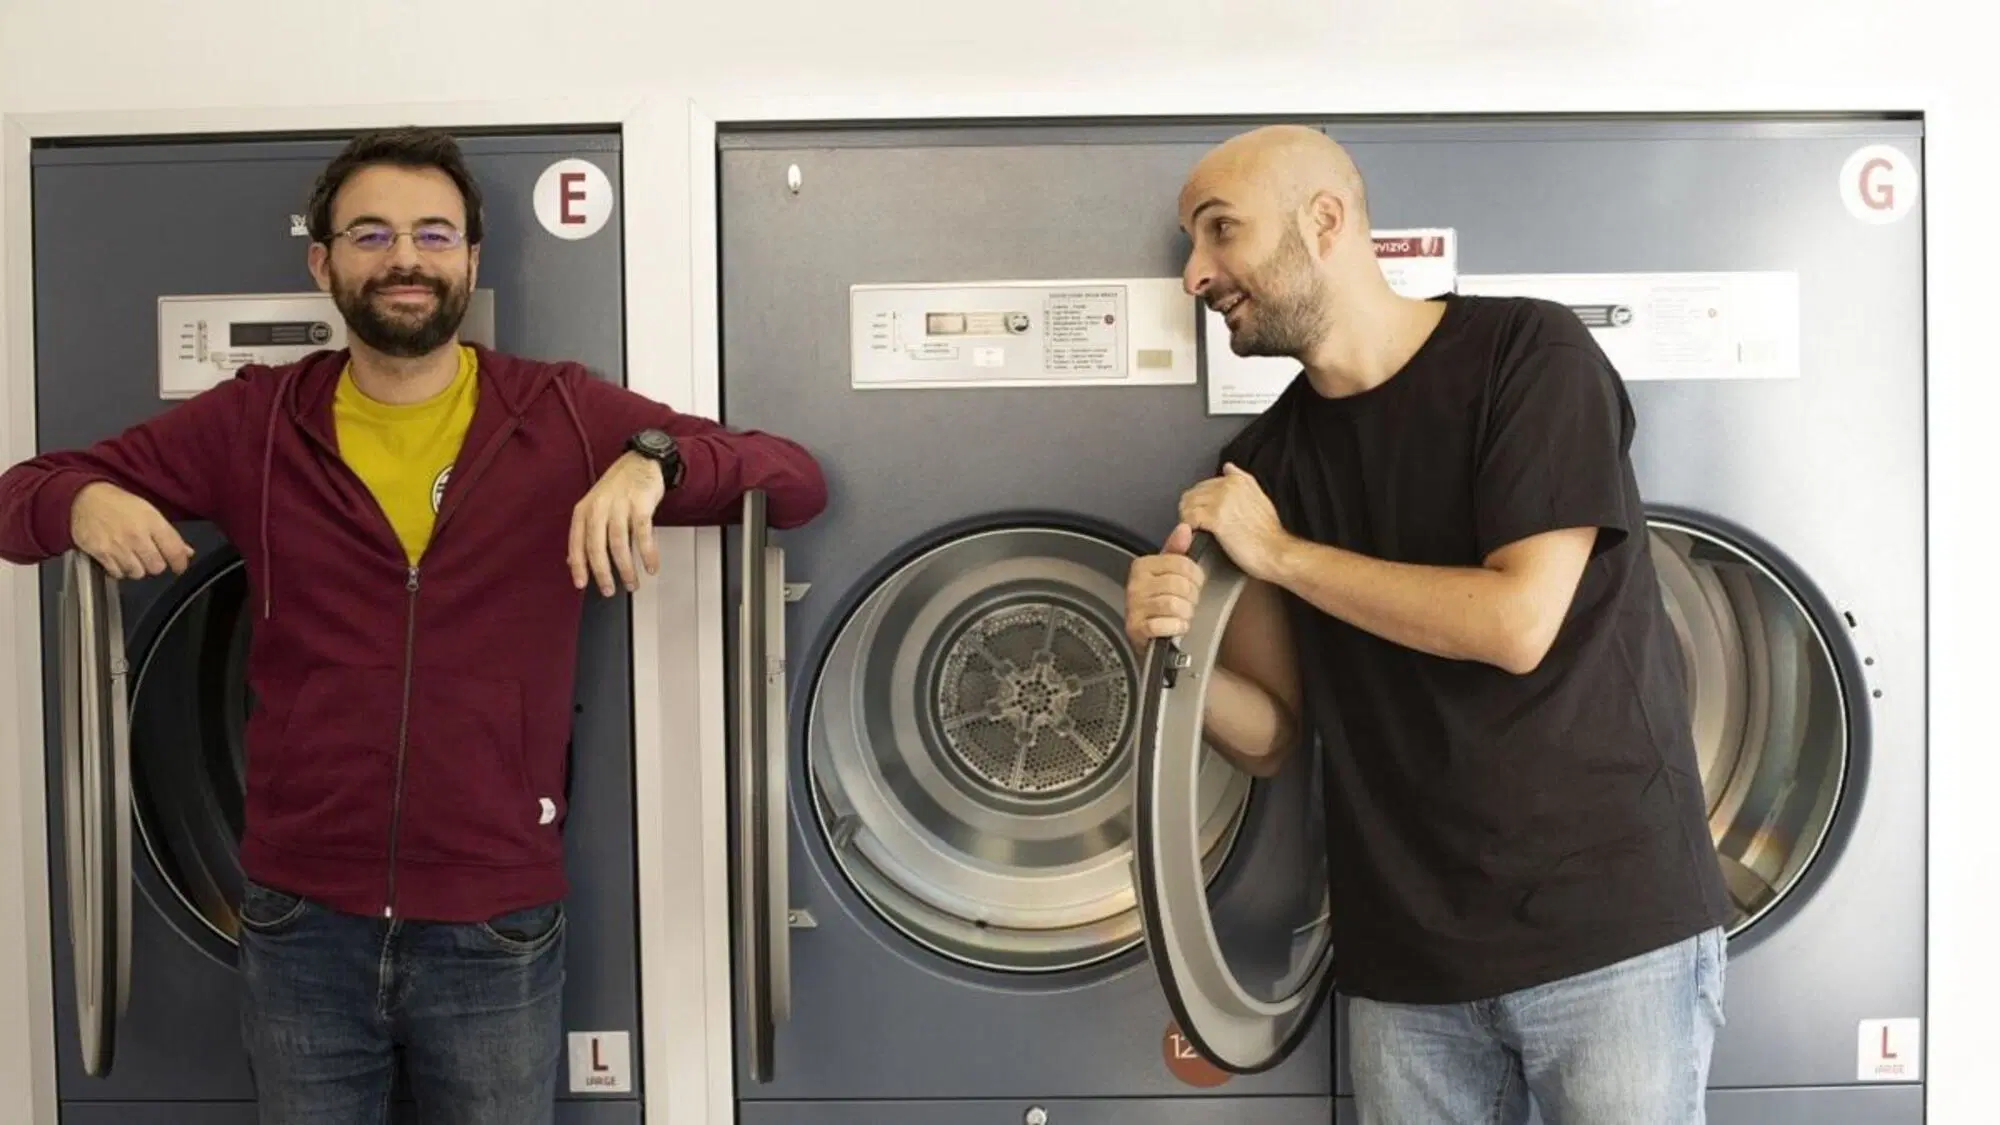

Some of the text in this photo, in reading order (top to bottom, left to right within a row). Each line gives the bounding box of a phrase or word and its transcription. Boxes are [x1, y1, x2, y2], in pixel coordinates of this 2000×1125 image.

[560, 172, 586, 224] E
[1859, 157, 1894, 210] G
[592, 1038, 609, 1071] L
[1881, 1025, 1898, 1059] L
